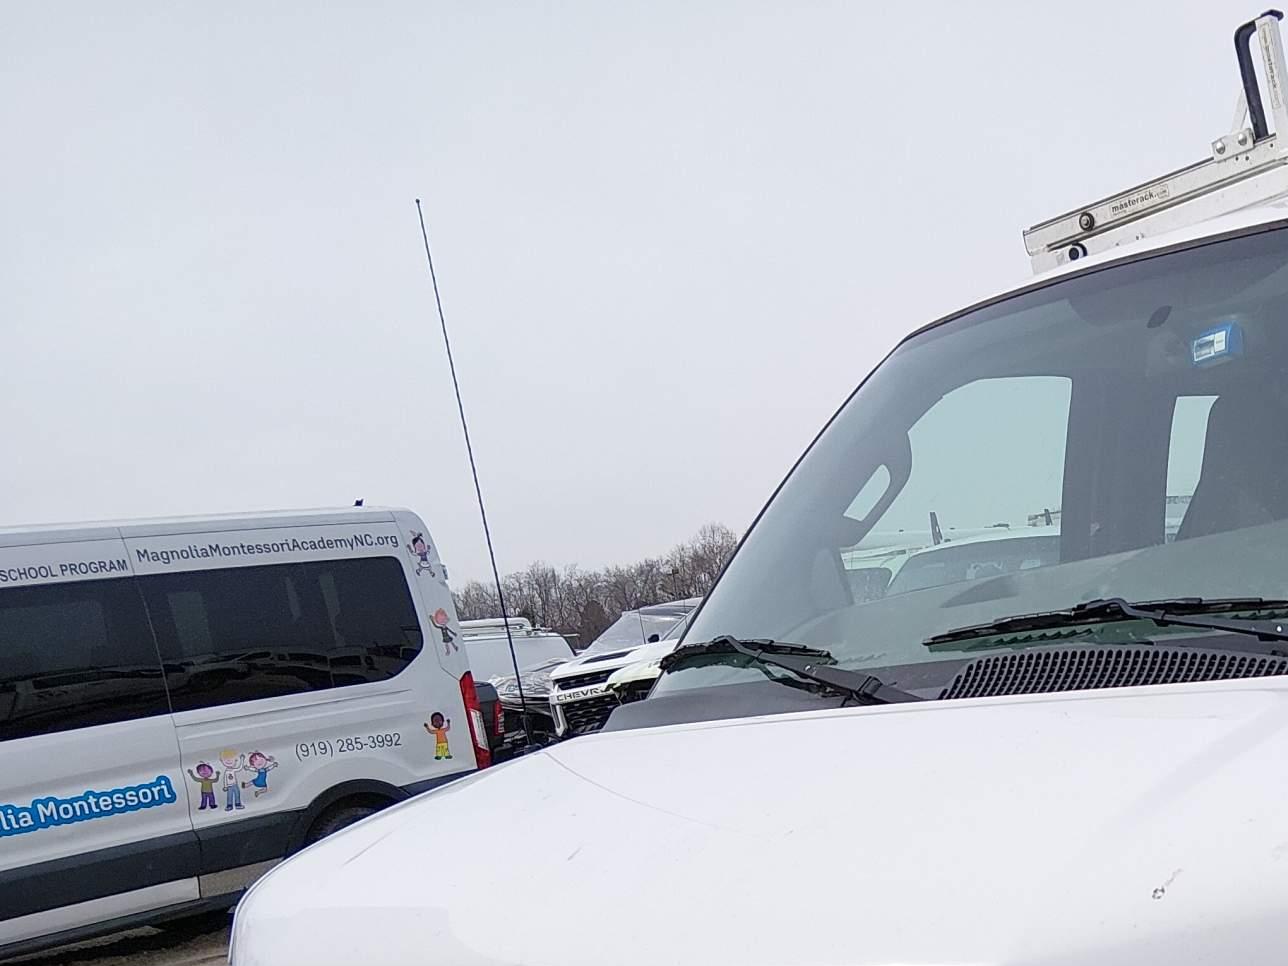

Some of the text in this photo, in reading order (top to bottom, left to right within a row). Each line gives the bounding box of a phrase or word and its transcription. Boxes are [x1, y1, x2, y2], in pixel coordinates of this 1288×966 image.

[1111, 188, 1167, 213] masterack.
[135, 533, 399, 564] MagnoliaMontessoriAcademyNC.org
[59, 559, 129, 577] PROGRAM
[295, 732, 402, 762] (919) 285-3992
[36, 779, 172, 824] Montessori
